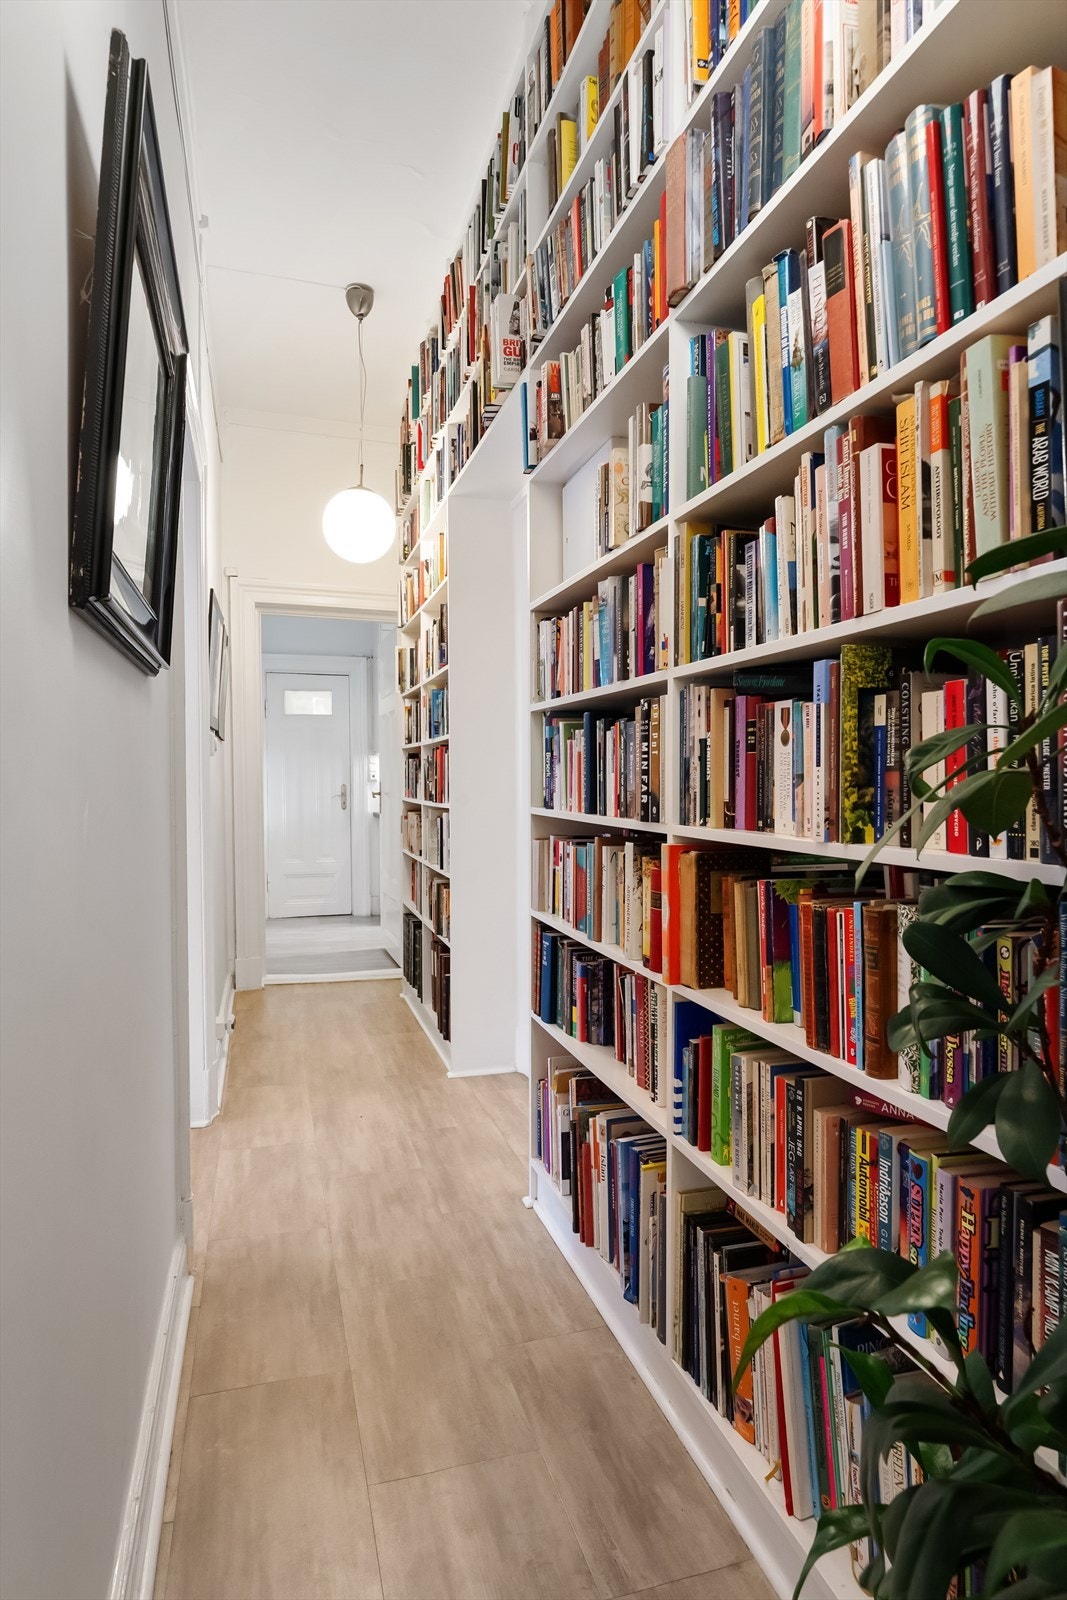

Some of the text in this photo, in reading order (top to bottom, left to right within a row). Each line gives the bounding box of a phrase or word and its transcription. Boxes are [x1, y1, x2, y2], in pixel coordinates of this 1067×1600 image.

[1032, 437, 1048, 465] ARAB
[1035, 423, 1046, 435] THE
[899, 459, 911, 512] ISLAM
[934, 465, 943, 540] ANTHROPOLOGY
[1032, 466, 1049, 501] WORLD
[1041, 645, 1049, 687] TORE PRYSER
[901, 682, 910, 744] COASTING
[599, 1153, 607, 1183] Islam
[788, 1137, 796, 1161] JEG
[859, 1156, 870, 1223] Automobil
[878, 1158, 891, 1224] Indriðason
[909, 1180, 922, 1248] SUPER
[955, 1209, 977, 1351] Happy Ending
[1044, 1249, 1059, 1316] MIN KAMP
[731, 1299, 741, 1341] barnet
